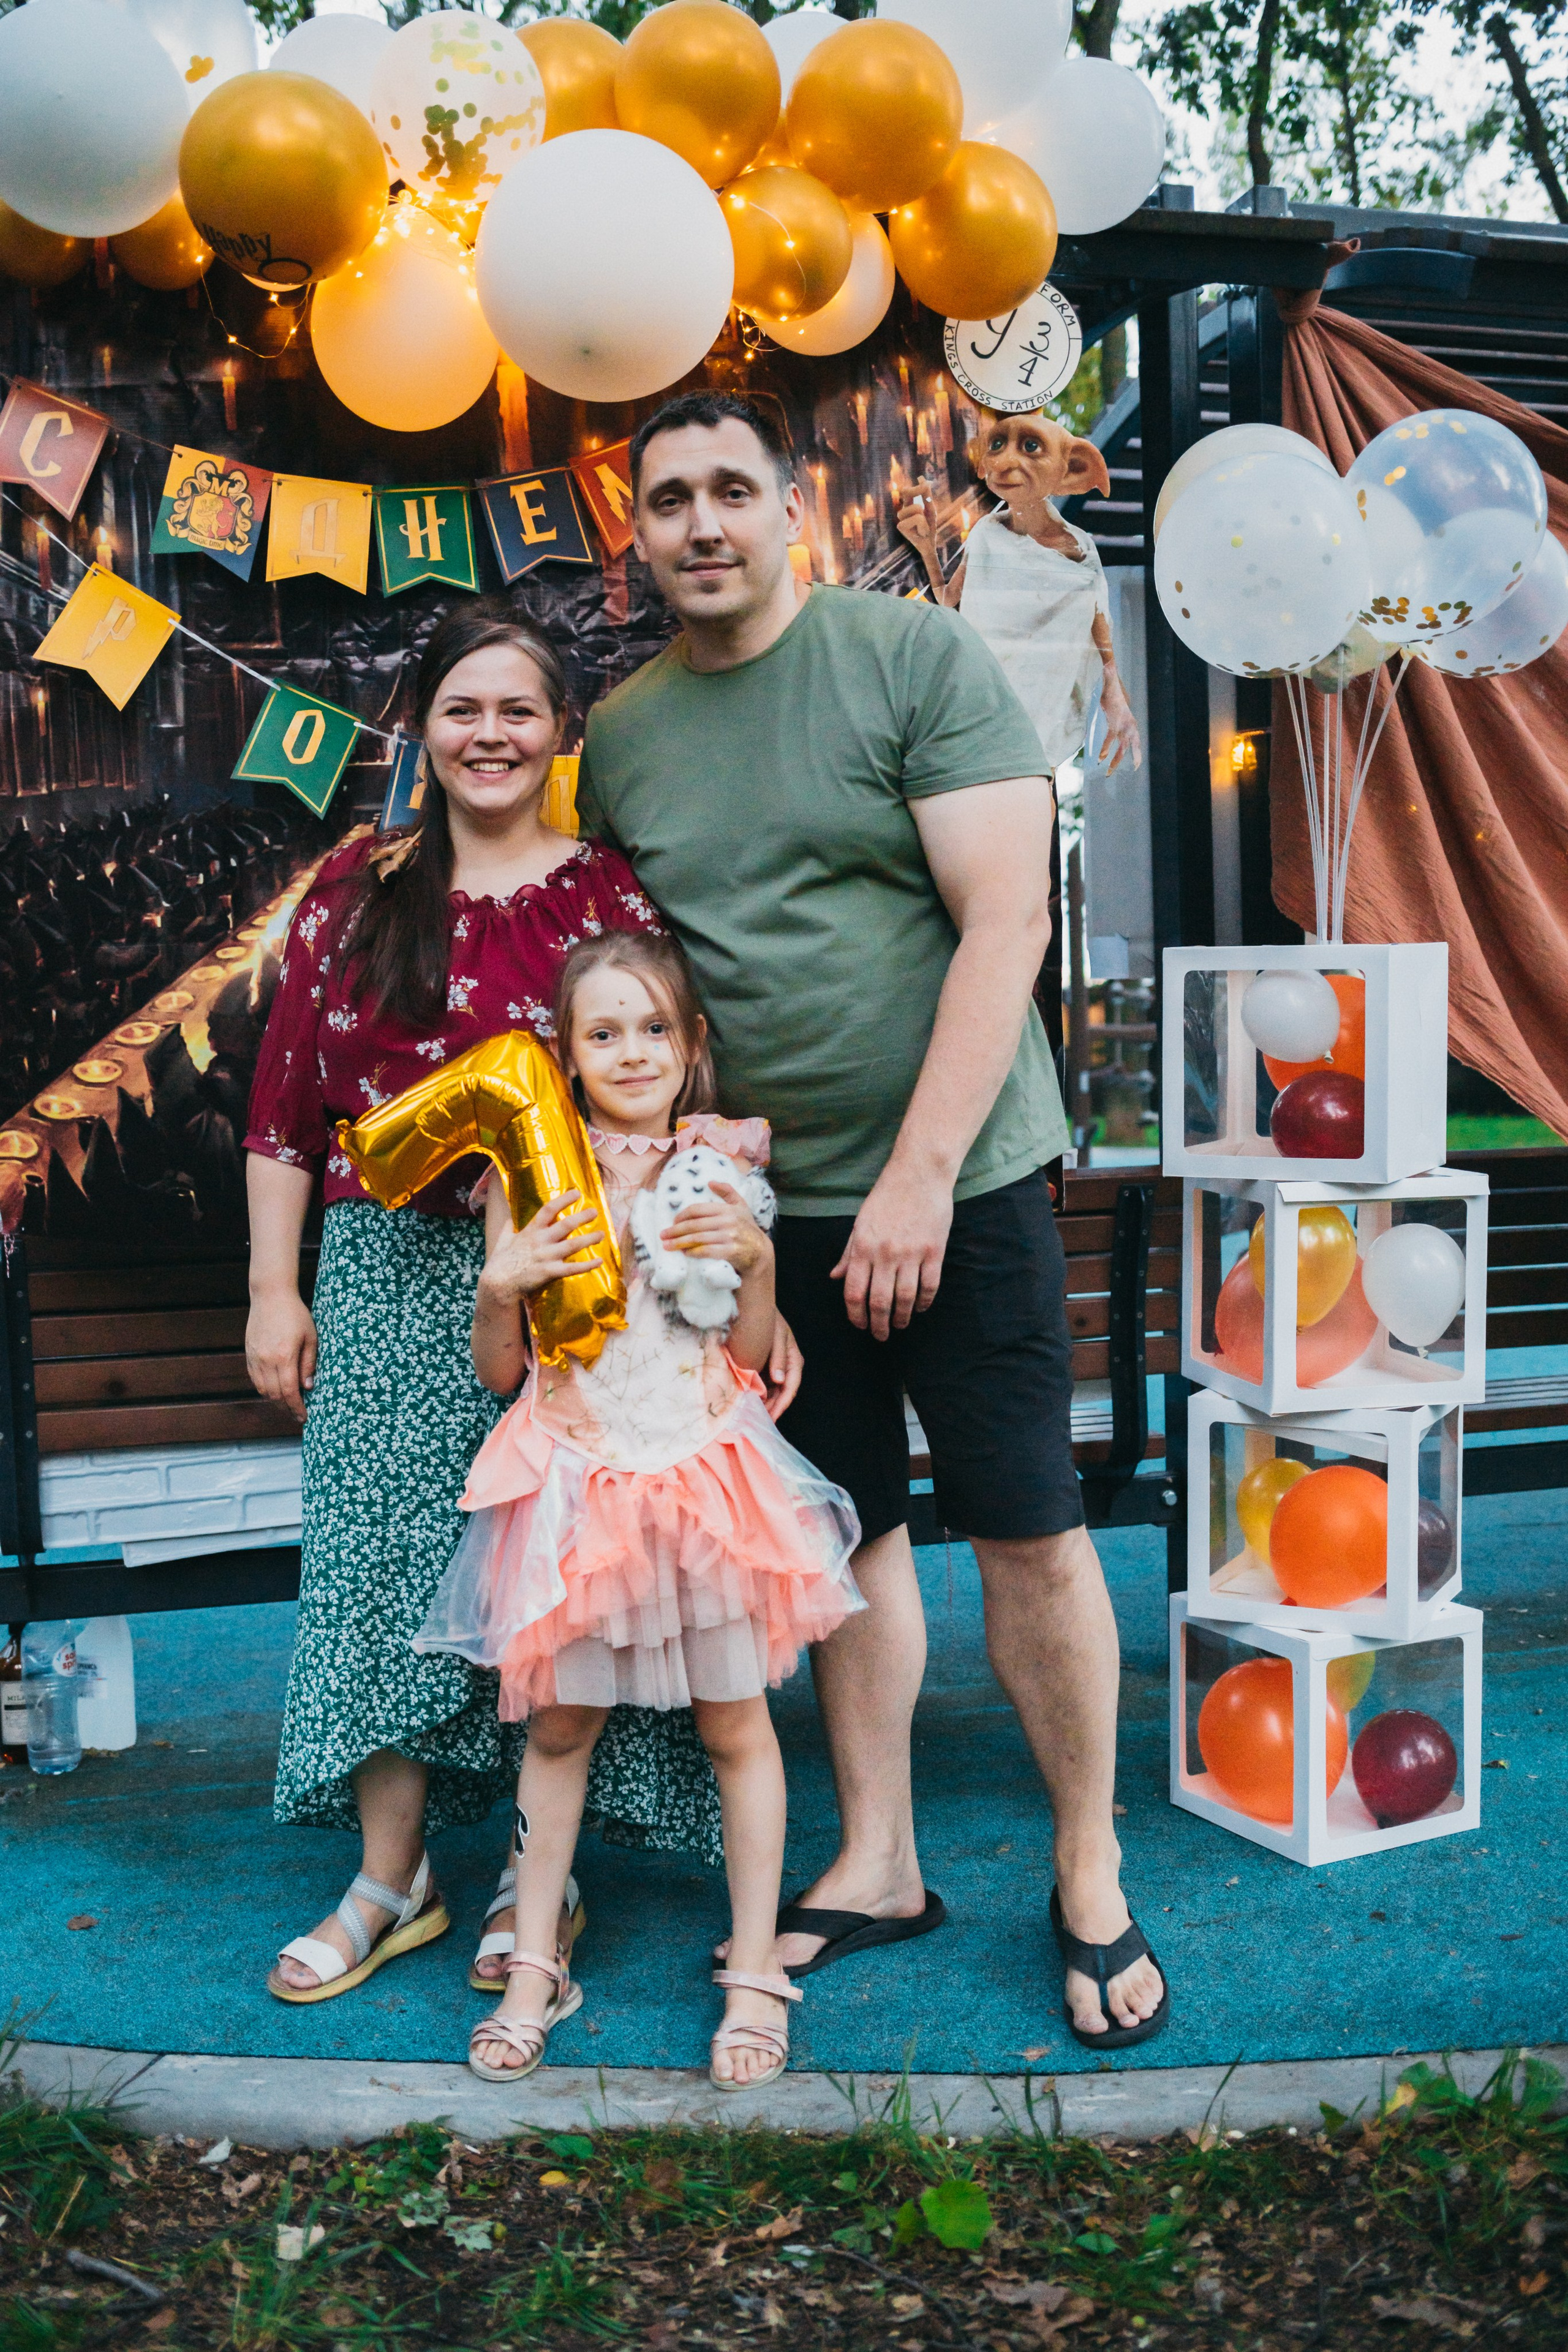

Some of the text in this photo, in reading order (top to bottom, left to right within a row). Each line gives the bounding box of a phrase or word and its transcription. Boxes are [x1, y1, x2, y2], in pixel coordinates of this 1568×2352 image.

[944, 325, 1054, 411] KINGS CROSS STATION
[208, 539, 224, 549] time
